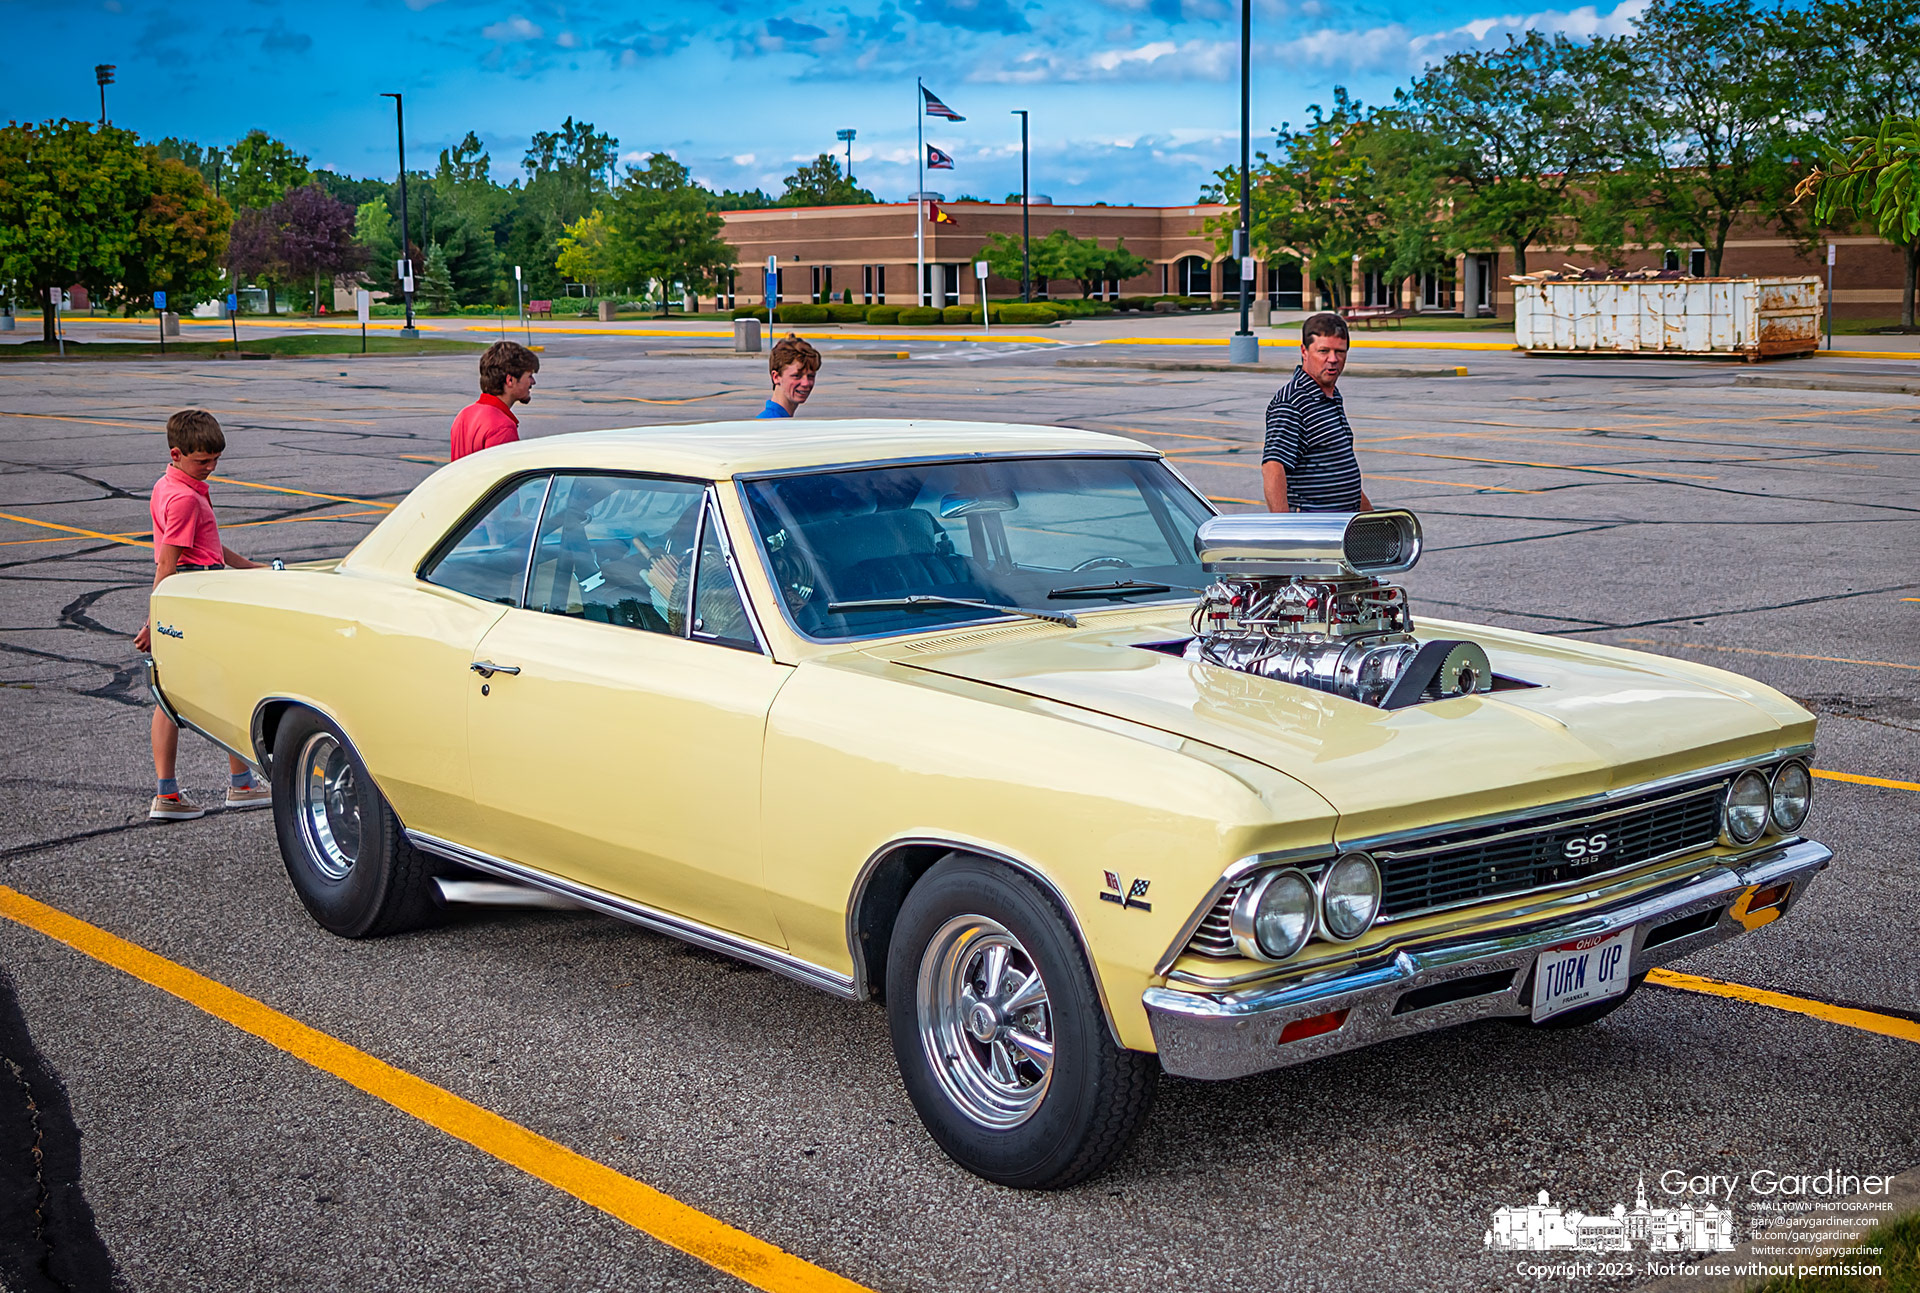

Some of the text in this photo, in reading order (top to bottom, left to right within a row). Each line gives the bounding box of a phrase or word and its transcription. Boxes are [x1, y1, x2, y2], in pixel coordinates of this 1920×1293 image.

[1564, 833, 1608, 858] SS
[1576, 936, 1602, 950] OHIO
[1546, 944, 1623, 1001] TURN UP
[1562, 992, 1590, 1004] FRANKLIN
